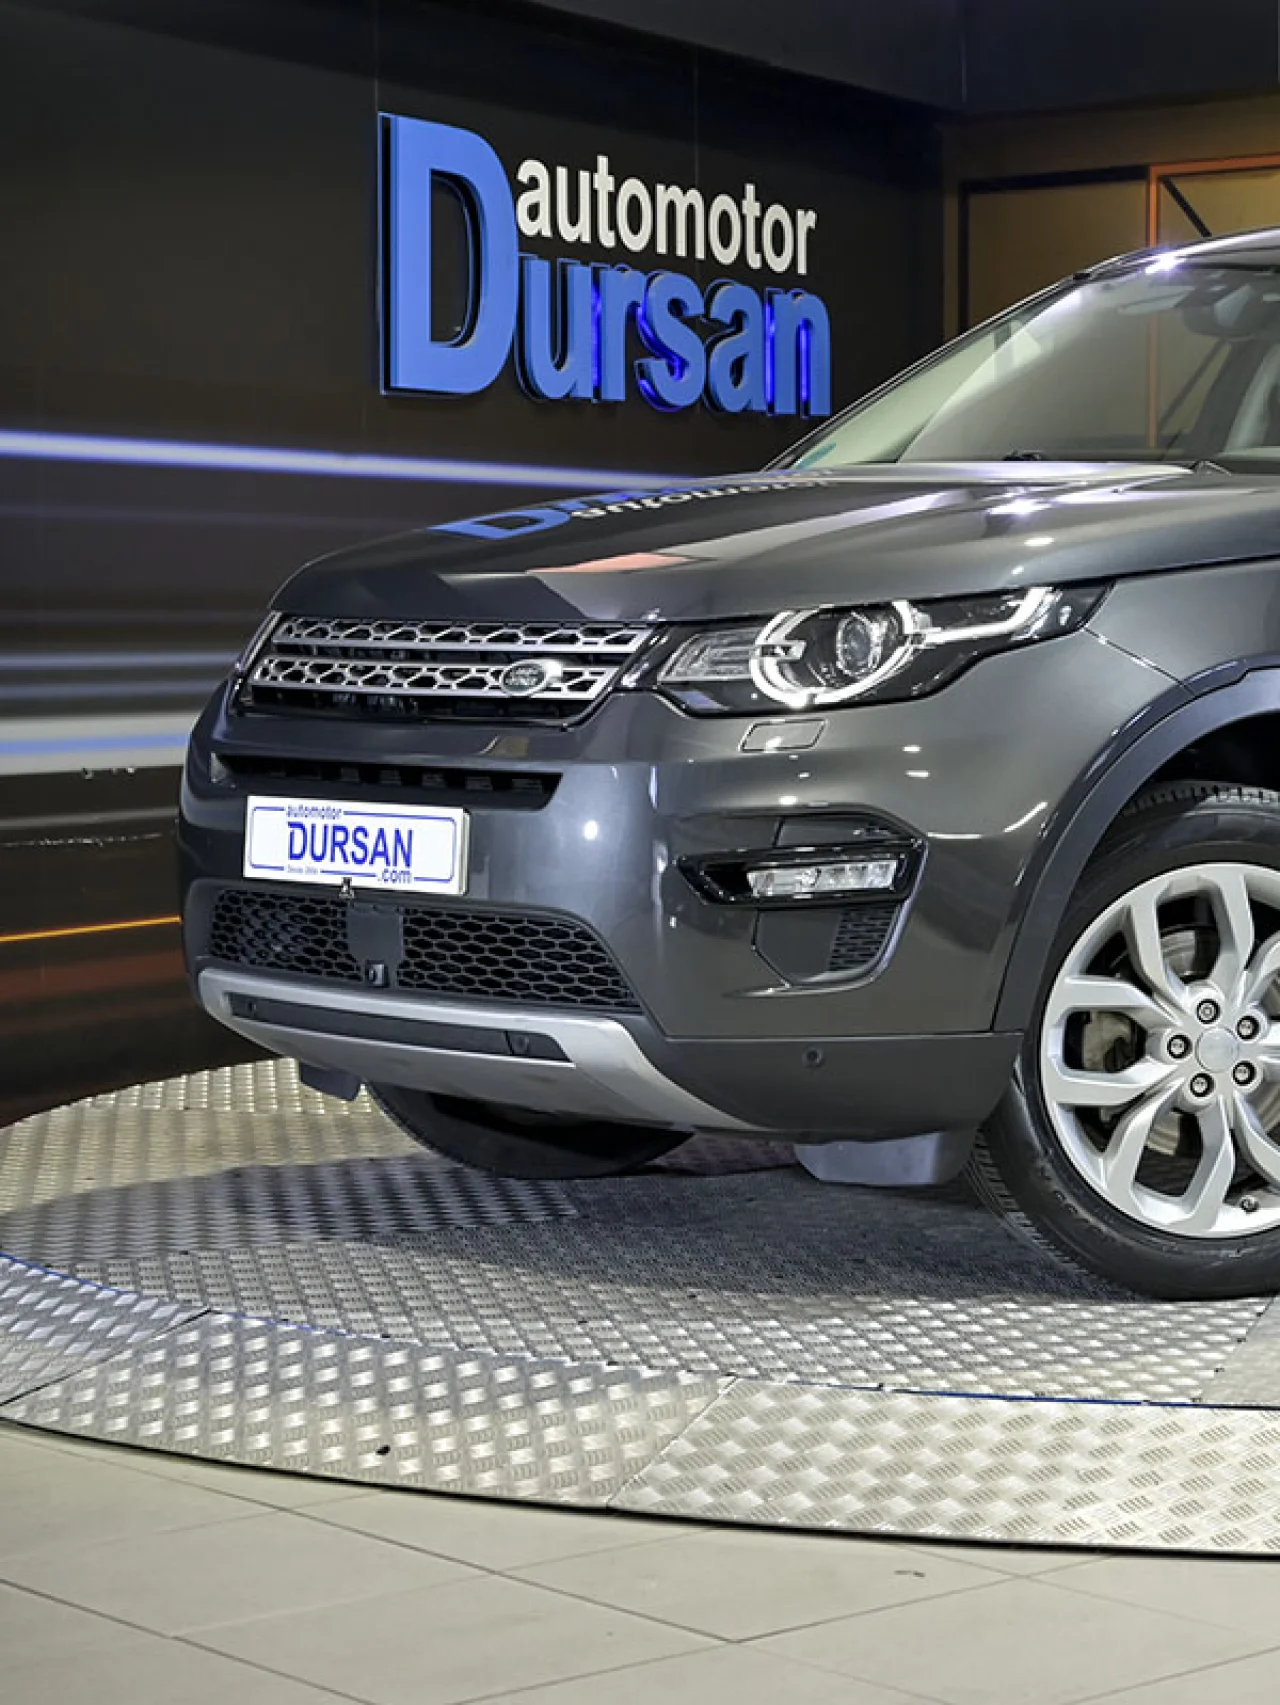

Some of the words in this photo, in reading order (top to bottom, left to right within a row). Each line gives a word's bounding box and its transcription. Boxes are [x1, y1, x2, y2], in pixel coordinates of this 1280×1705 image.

[516, 155, 818, 275] automotor
[379, 111, 832, 418] Dursan
[286, 804, 342, 820] automotor
[287, 821, 413, 867] DURSAN
[377, 868, 413, 884] .com
